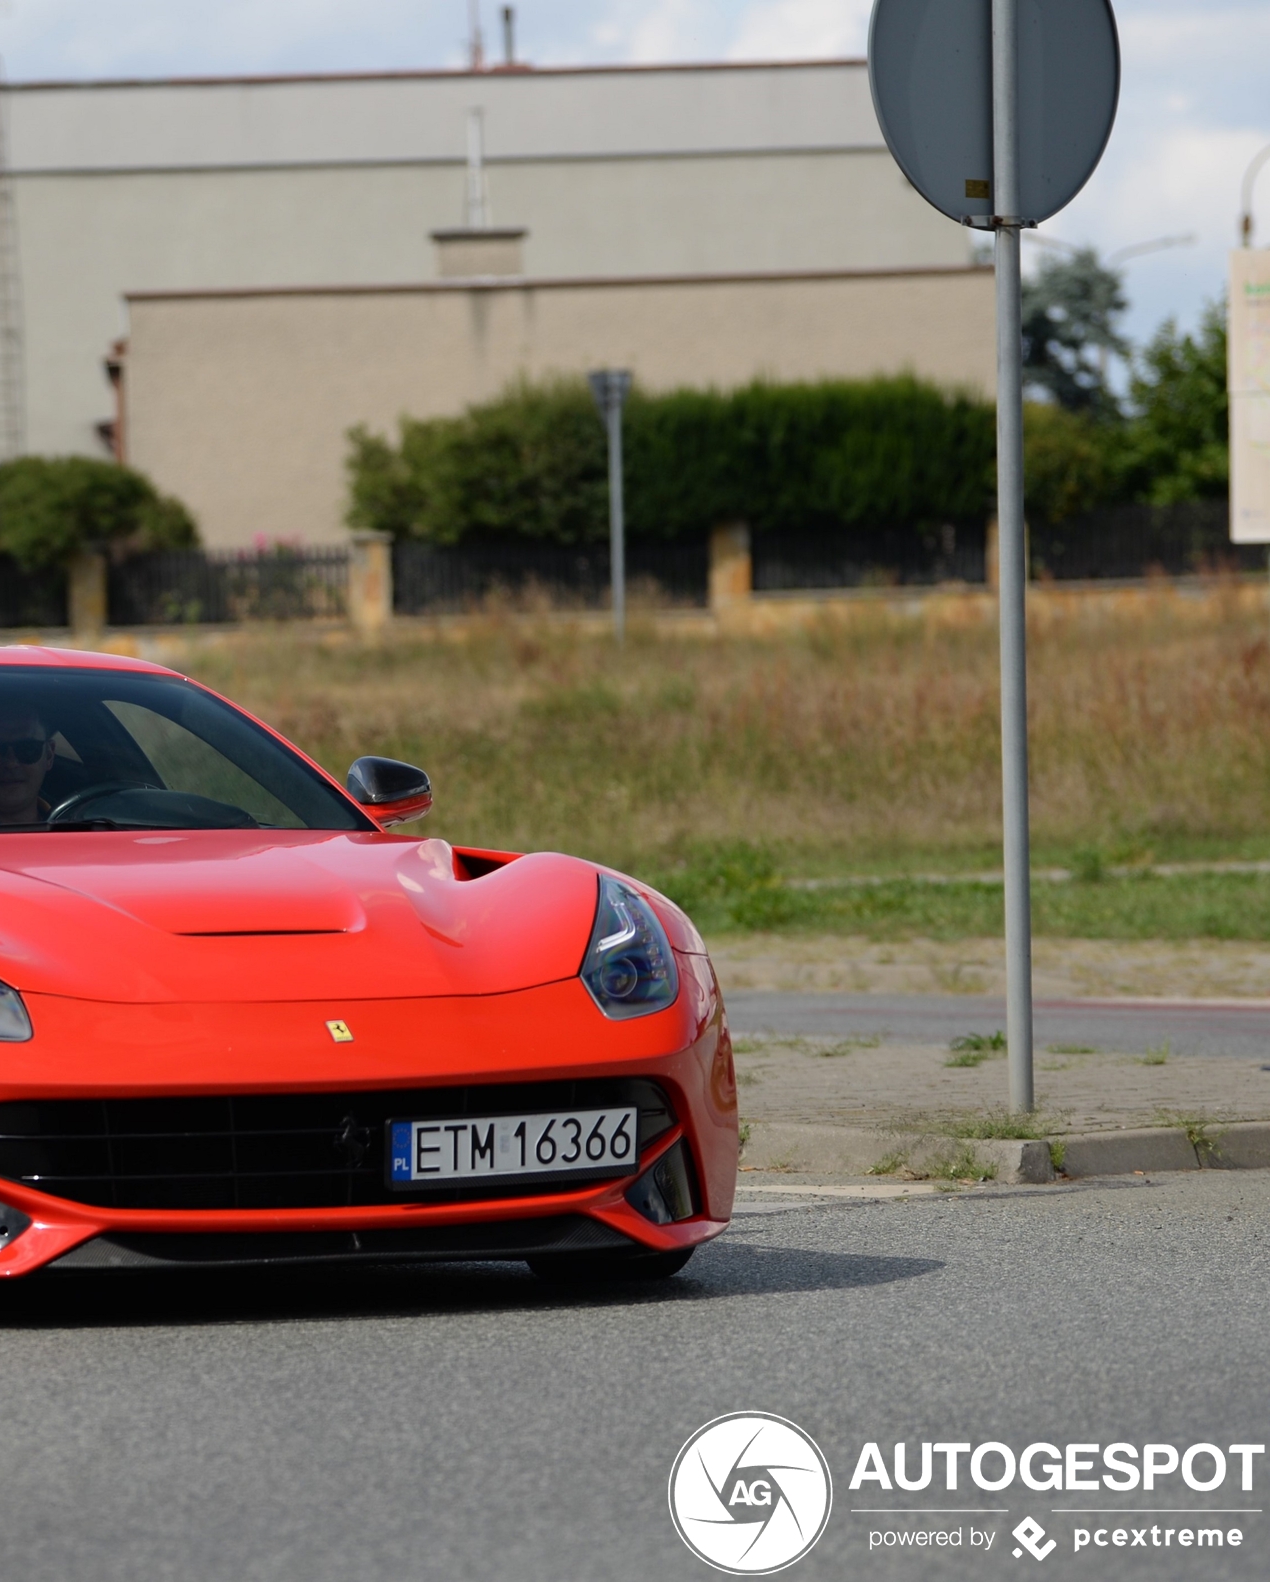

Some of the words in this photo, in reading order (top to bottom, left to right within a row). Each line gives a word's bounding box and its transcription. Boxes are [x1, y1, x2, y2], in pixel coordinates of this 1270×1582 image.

[416, 1122, 495, 1174] ETM
[513, 1113, 632, 1167] 16366
[393, 1158, 410, 1172] PL
